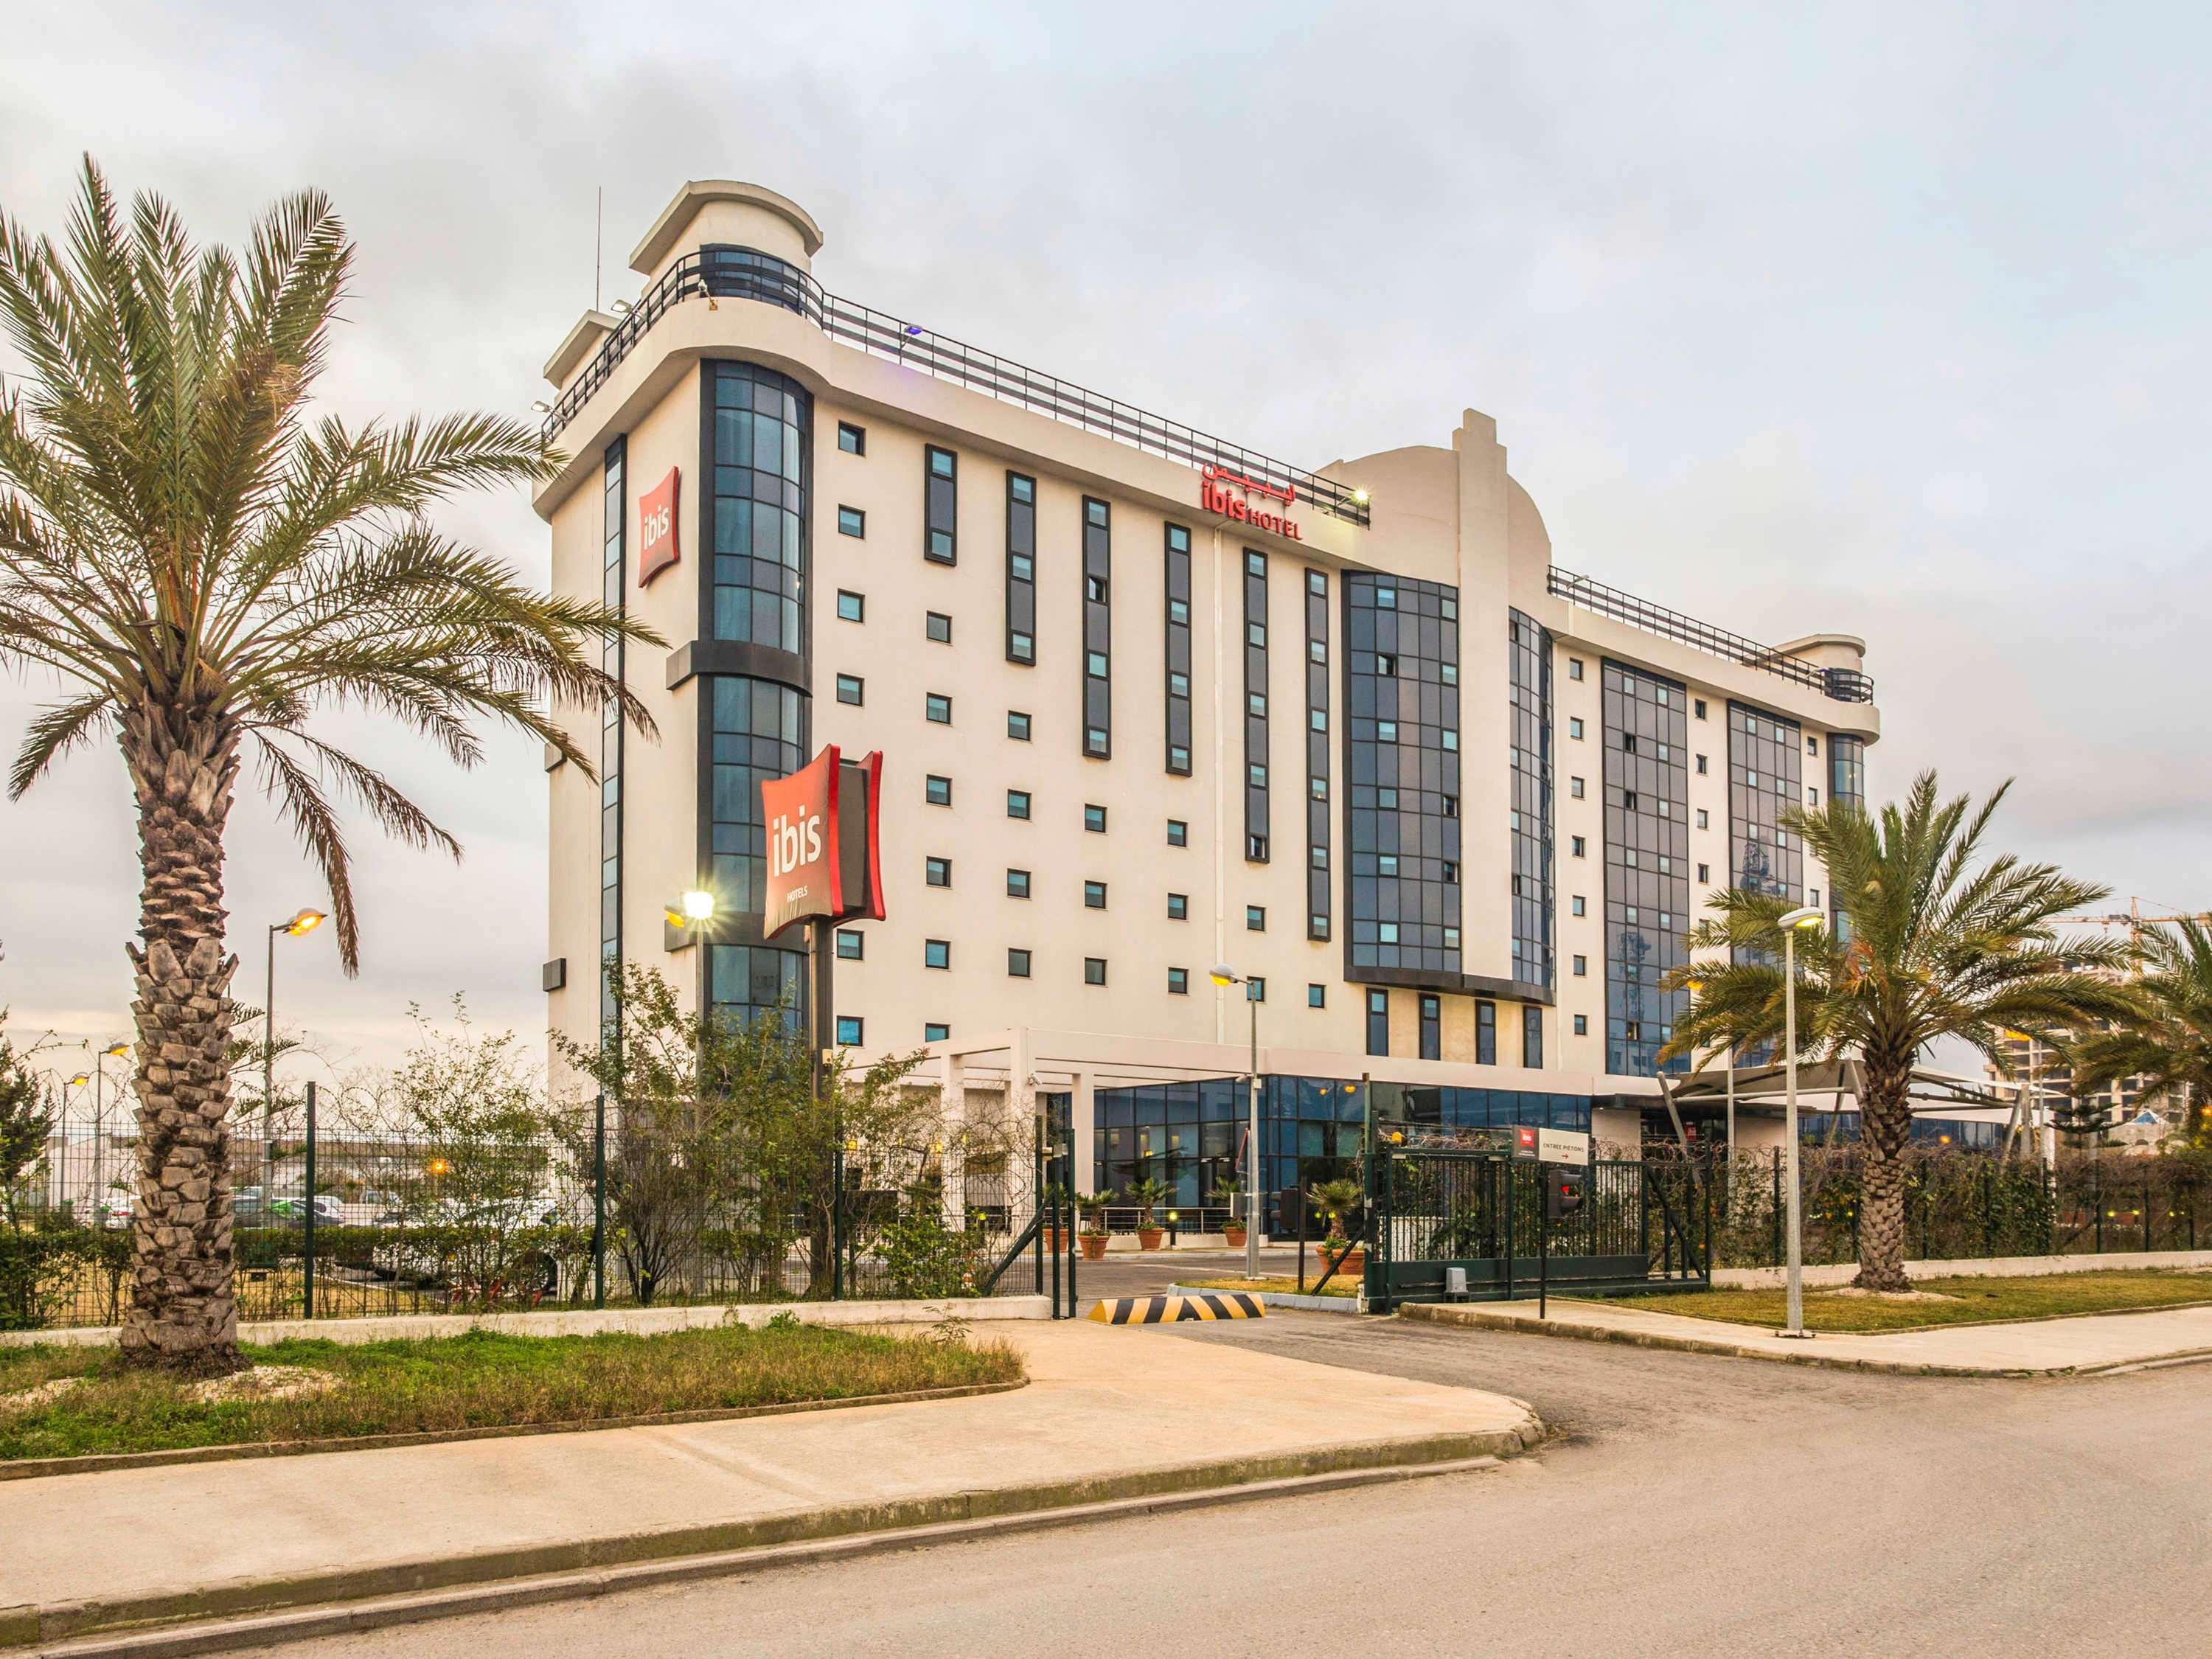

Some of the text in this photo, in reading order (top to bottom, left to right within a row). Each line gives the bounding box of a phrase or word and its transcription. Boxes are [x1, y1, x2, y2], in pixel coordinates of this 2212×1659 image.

[644, 504, 669, 550] ibis
[1202, 481, 1304, 540] ibis HOTEL
[773, 805, 821, 877] ibis
[787, 886, 808, 902] HOTELS
